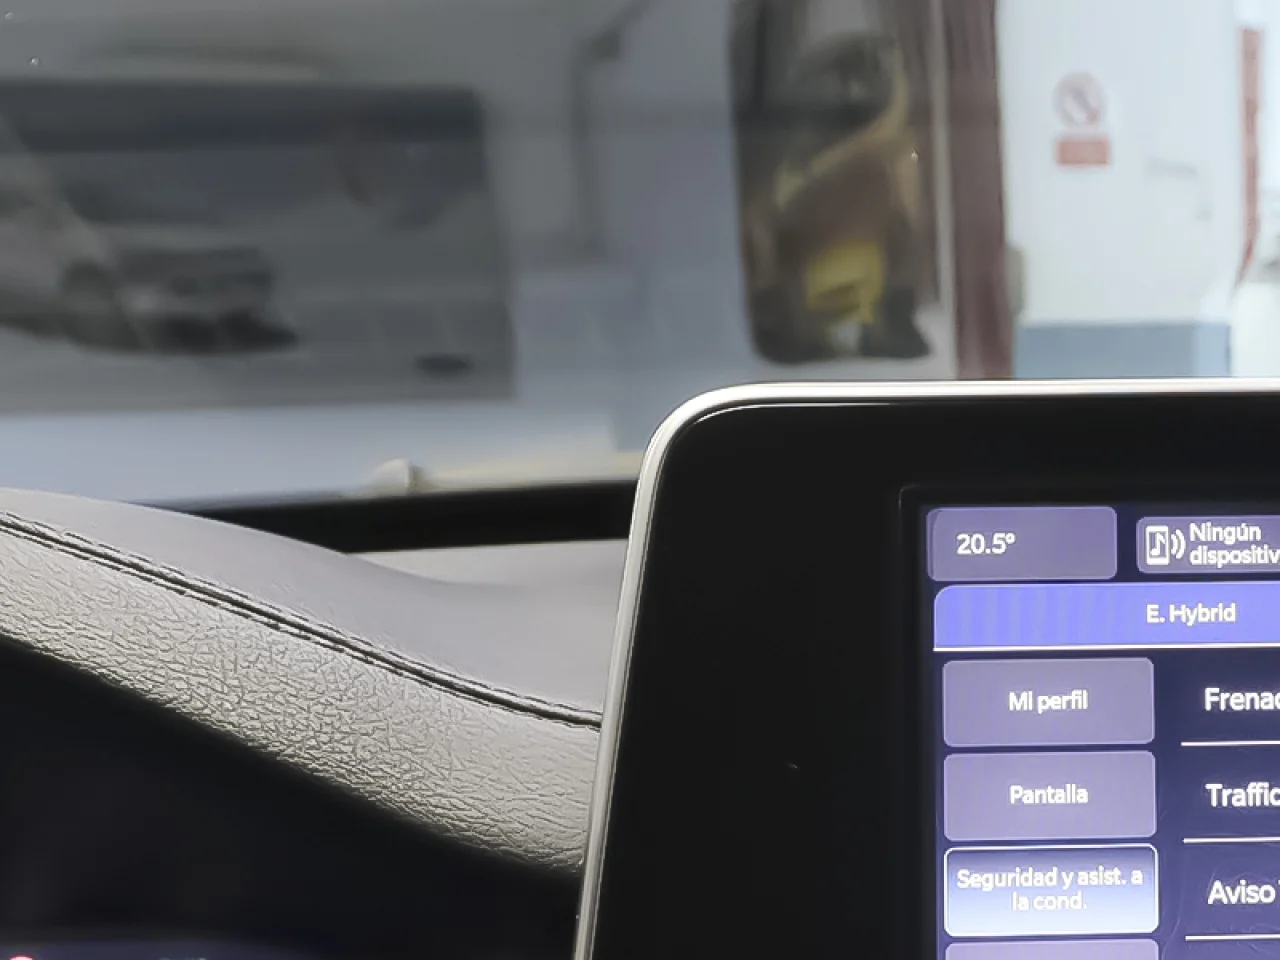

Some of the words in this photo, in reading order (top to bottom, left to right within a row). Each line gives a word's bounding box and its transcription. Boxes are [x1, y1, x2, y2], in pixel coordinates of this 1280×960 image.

[1189, 521, 1261, 543] Ningún
[1146, 604, 1165, 622] E.
[1169, 602, 1235, 626] Hybrid
[1036, 689, 1088, 714] perfil
[1009, 783, 1088, 803] Pantalla
[956, 866, 1058, 892] Seguridad
[1061, 871, 1074, 890] y
[1075, 865, 1127, 886] asist.
[1130, 869, 1143, 885] a
[1012, 890, 1029, 911] la
[1033, 889, 1087, 910] cond.
[1207, 879, 1275, 904] Aviso
